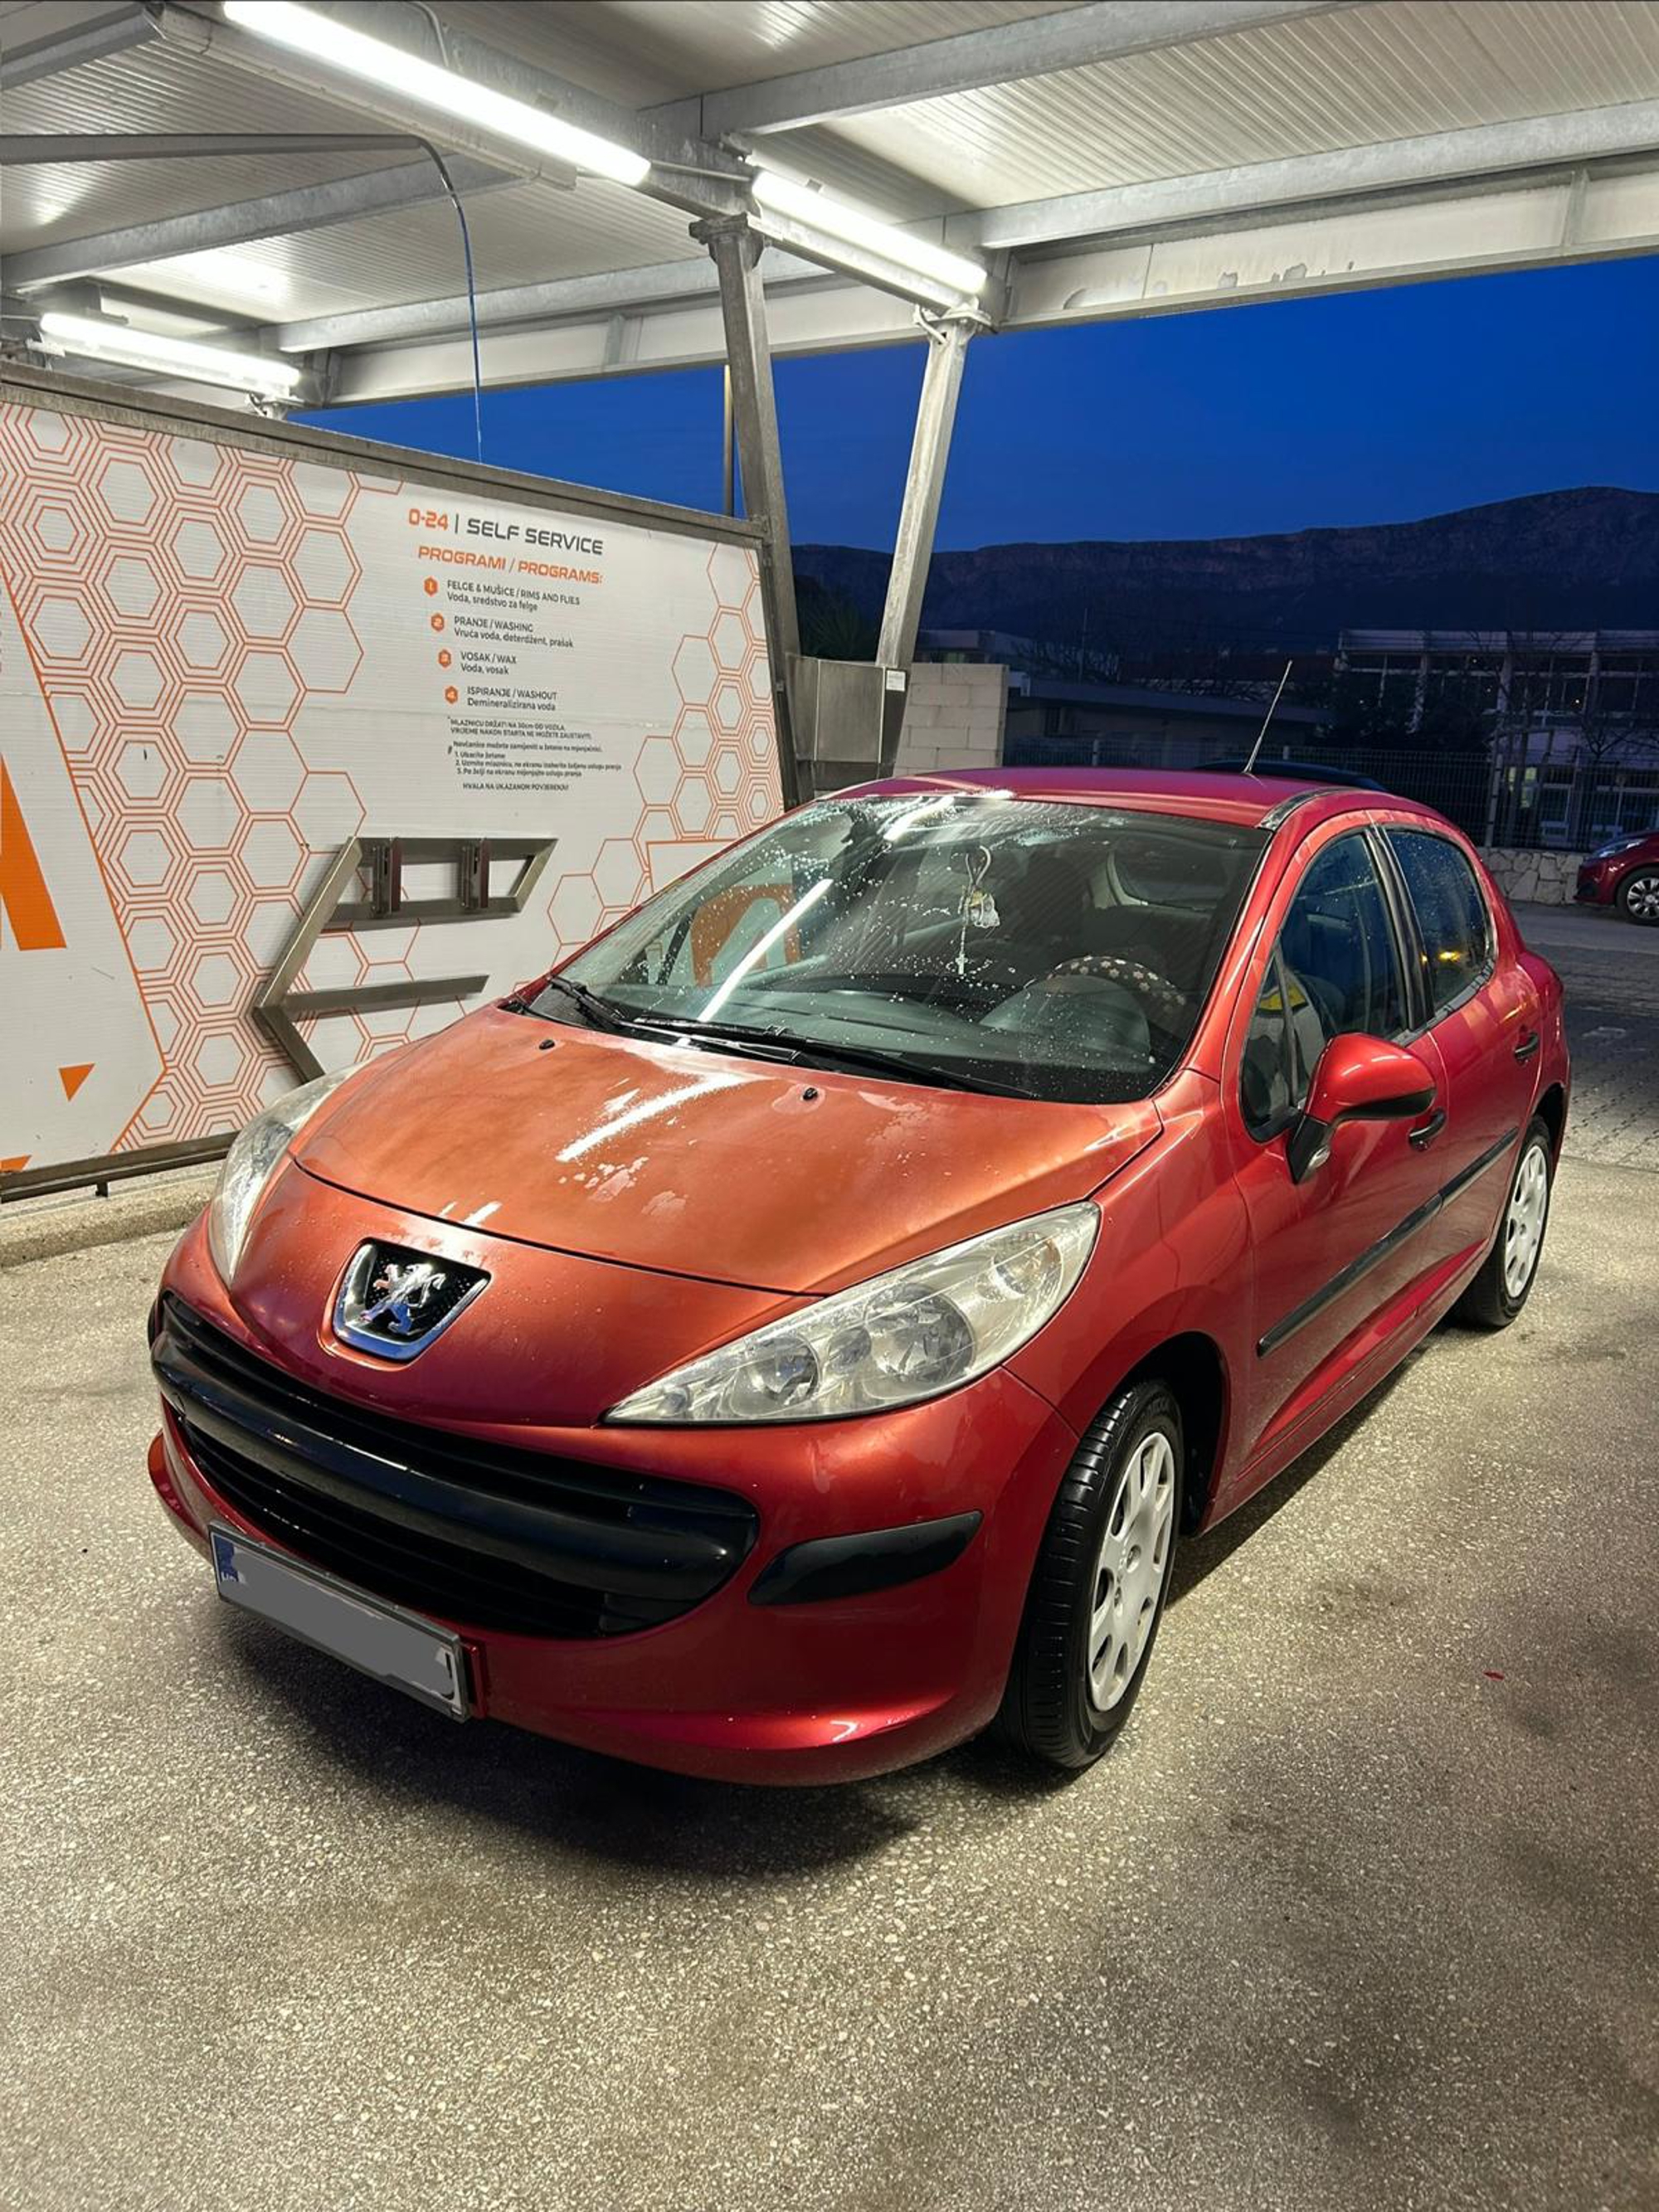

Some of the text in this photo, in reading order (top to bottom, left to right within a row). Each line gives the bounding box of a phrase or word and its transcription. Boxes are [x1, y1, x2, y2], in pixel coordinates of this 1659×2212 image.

[409, 508, 449, 531] 0-24
[466, 518, 519, 540] SELF
[525, 527, 603, 555] SERVICE
[418, 546, 507, 570] PROGRAMI
[518, 561, 603, 584] PROGRAMS:
[447, 580, 474, 592] FELGE
[476, 584, 482, 593] &
[484, 584, 515, 596] MUŠICE
[521, 589, 540, 600] RIMS
[542, 592, 559, 603] AND
[560, 595, 580, 605] FLIES
[447, 591, 538, 612] Voda, sredstvo za felge
[454, 615, 489, 629] PRANJE
[494, 620, 533, 633] WASHING
[460, 651, 491, 663] VOSAK
[497, 654, 517, 664] WAX
[460, 663, 509, 675] Voda, vosak
[467, 686, 511, 698] ISPIRANJE
[517, 689, 557, 701] WASHOUT
[467, 698, 556, 712] Demineralizirana voda
